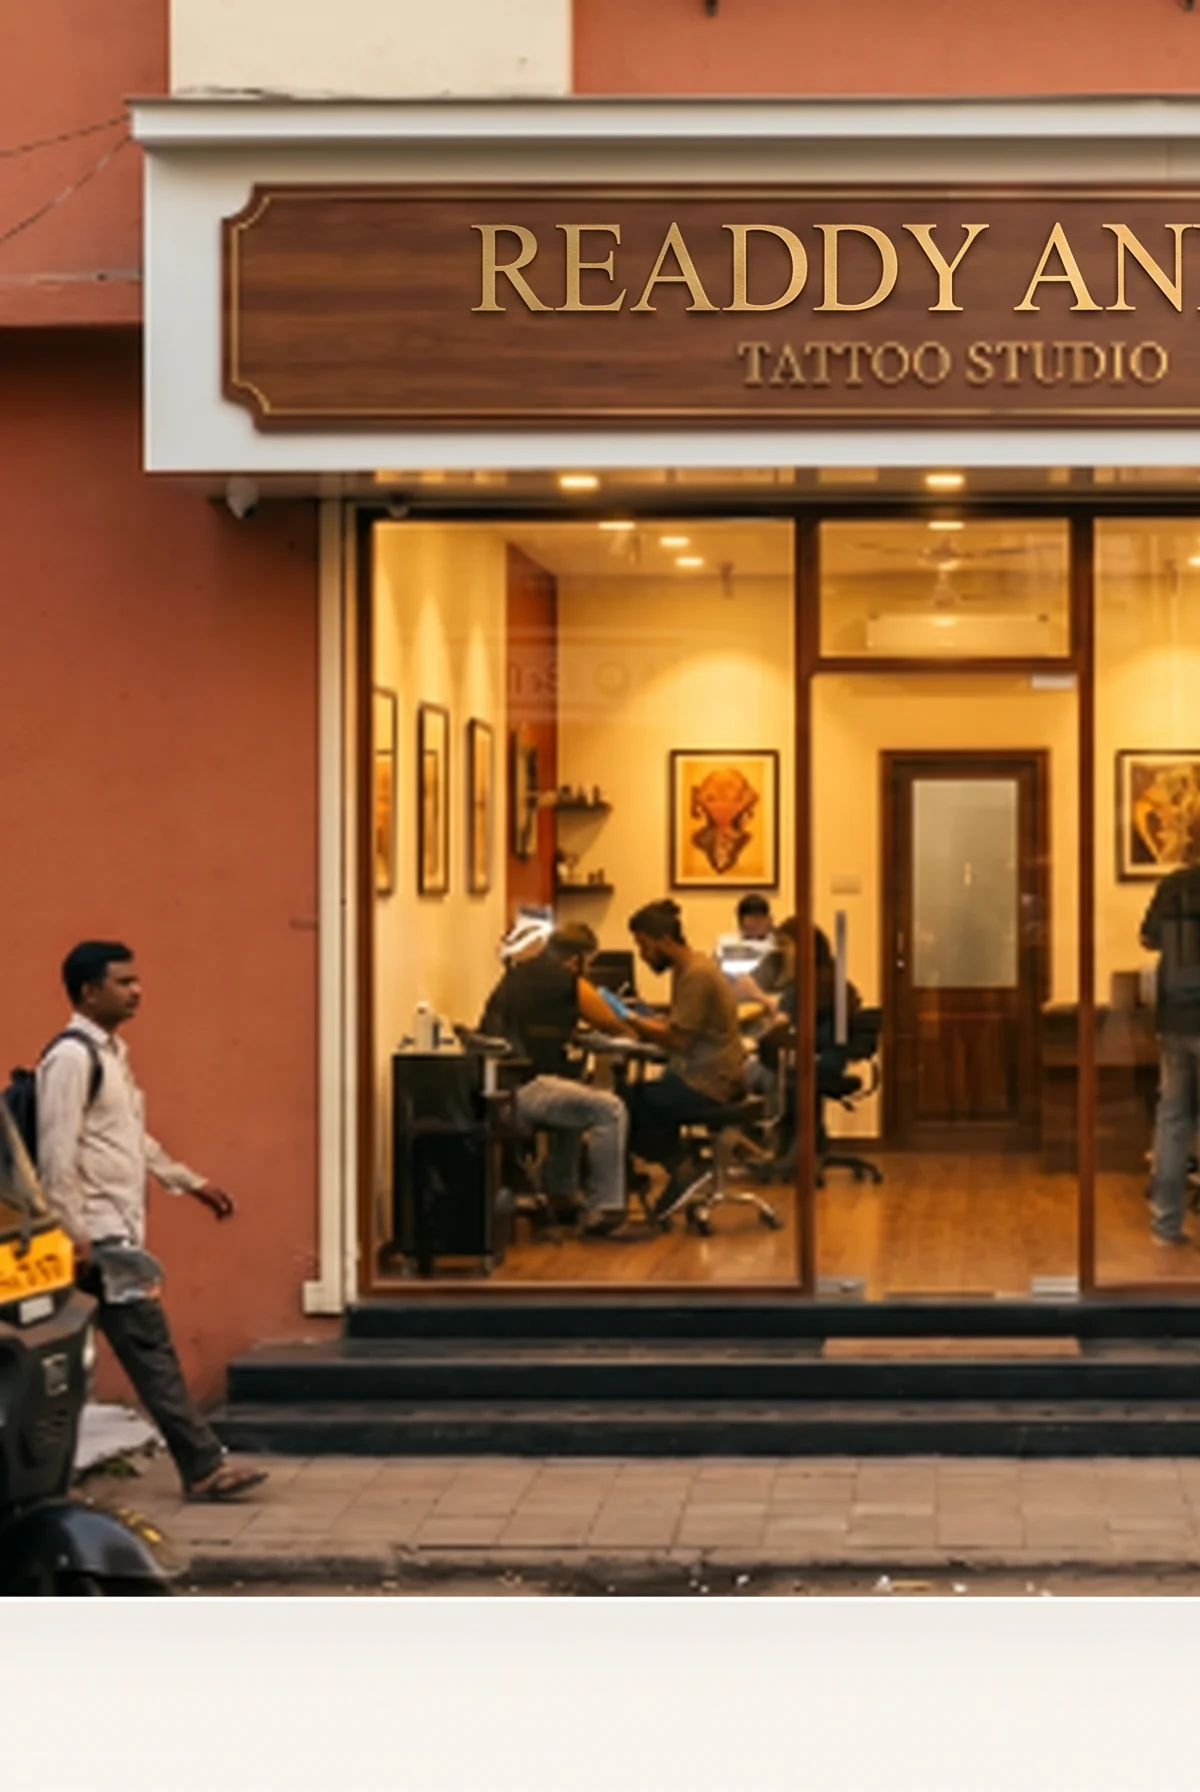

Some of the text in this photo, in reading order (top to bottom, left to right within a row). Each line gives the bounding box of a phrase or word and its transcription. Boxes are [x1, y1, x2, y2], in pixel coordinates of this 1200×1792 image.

[470, 222, 990, 313] READDY
[738, 340, 1169, 387] TATTOO STUDIO
